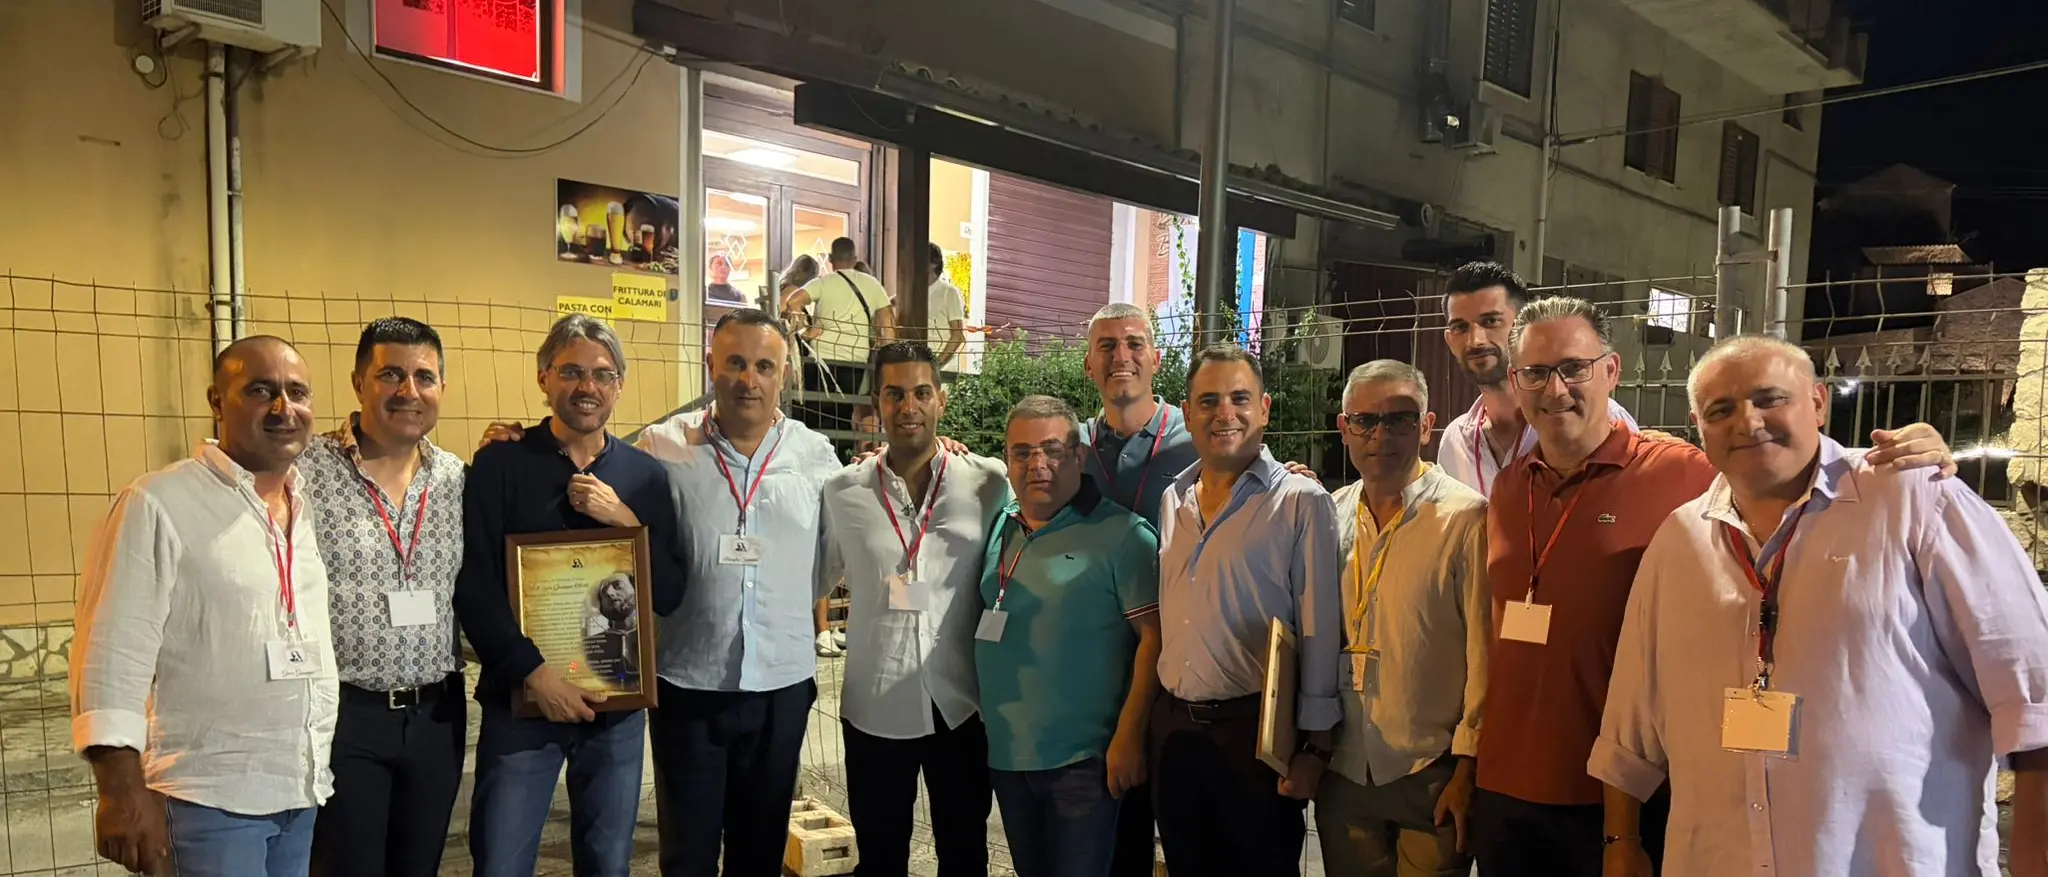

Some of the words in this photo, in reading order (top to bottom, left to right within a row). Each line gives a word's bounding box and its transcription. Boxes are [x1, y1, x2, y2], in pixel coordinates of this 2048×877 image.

[613, 285, 655, 297] FRITTURA
[558, 302, 588, 312] PASTA
[590, 304, 612, 313] CON
[617, 297, 662, 308] CALAMARI
